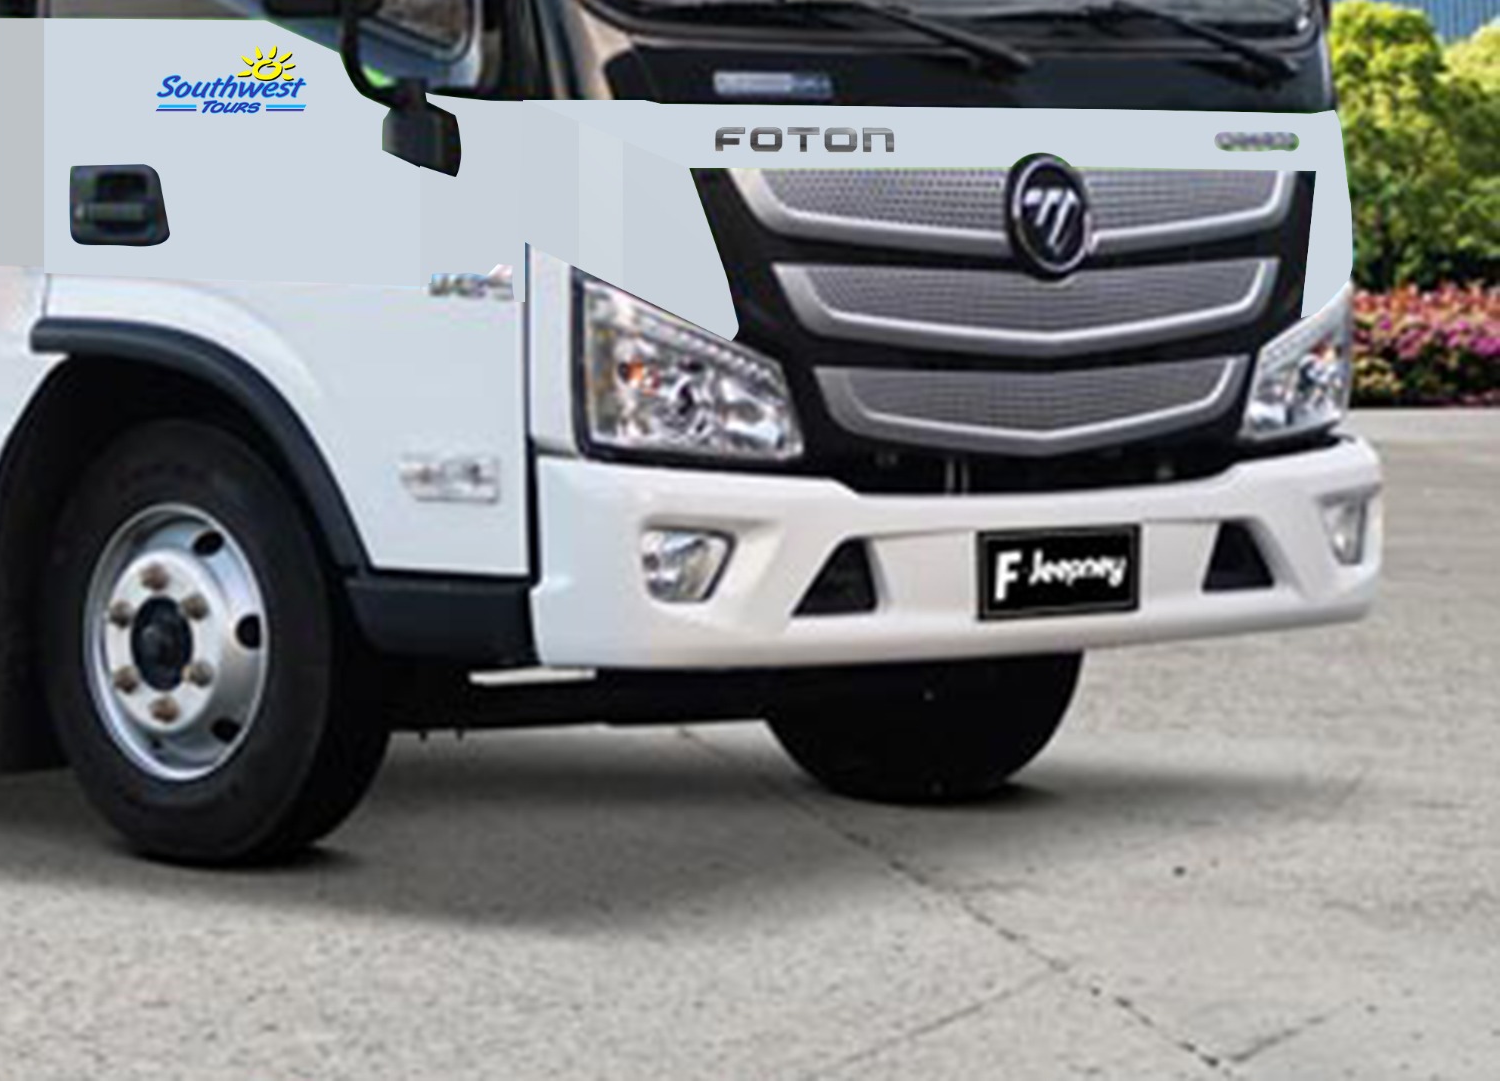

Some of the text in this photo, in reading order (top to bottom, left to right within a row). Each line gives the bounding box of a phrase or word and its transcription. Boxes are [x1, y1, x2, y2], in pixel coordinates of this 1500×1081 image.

[156, 74, 307, 99] Southwest
[201, 100, 262, 114] TOURS
[715, 126, 895, 153] FOTON
